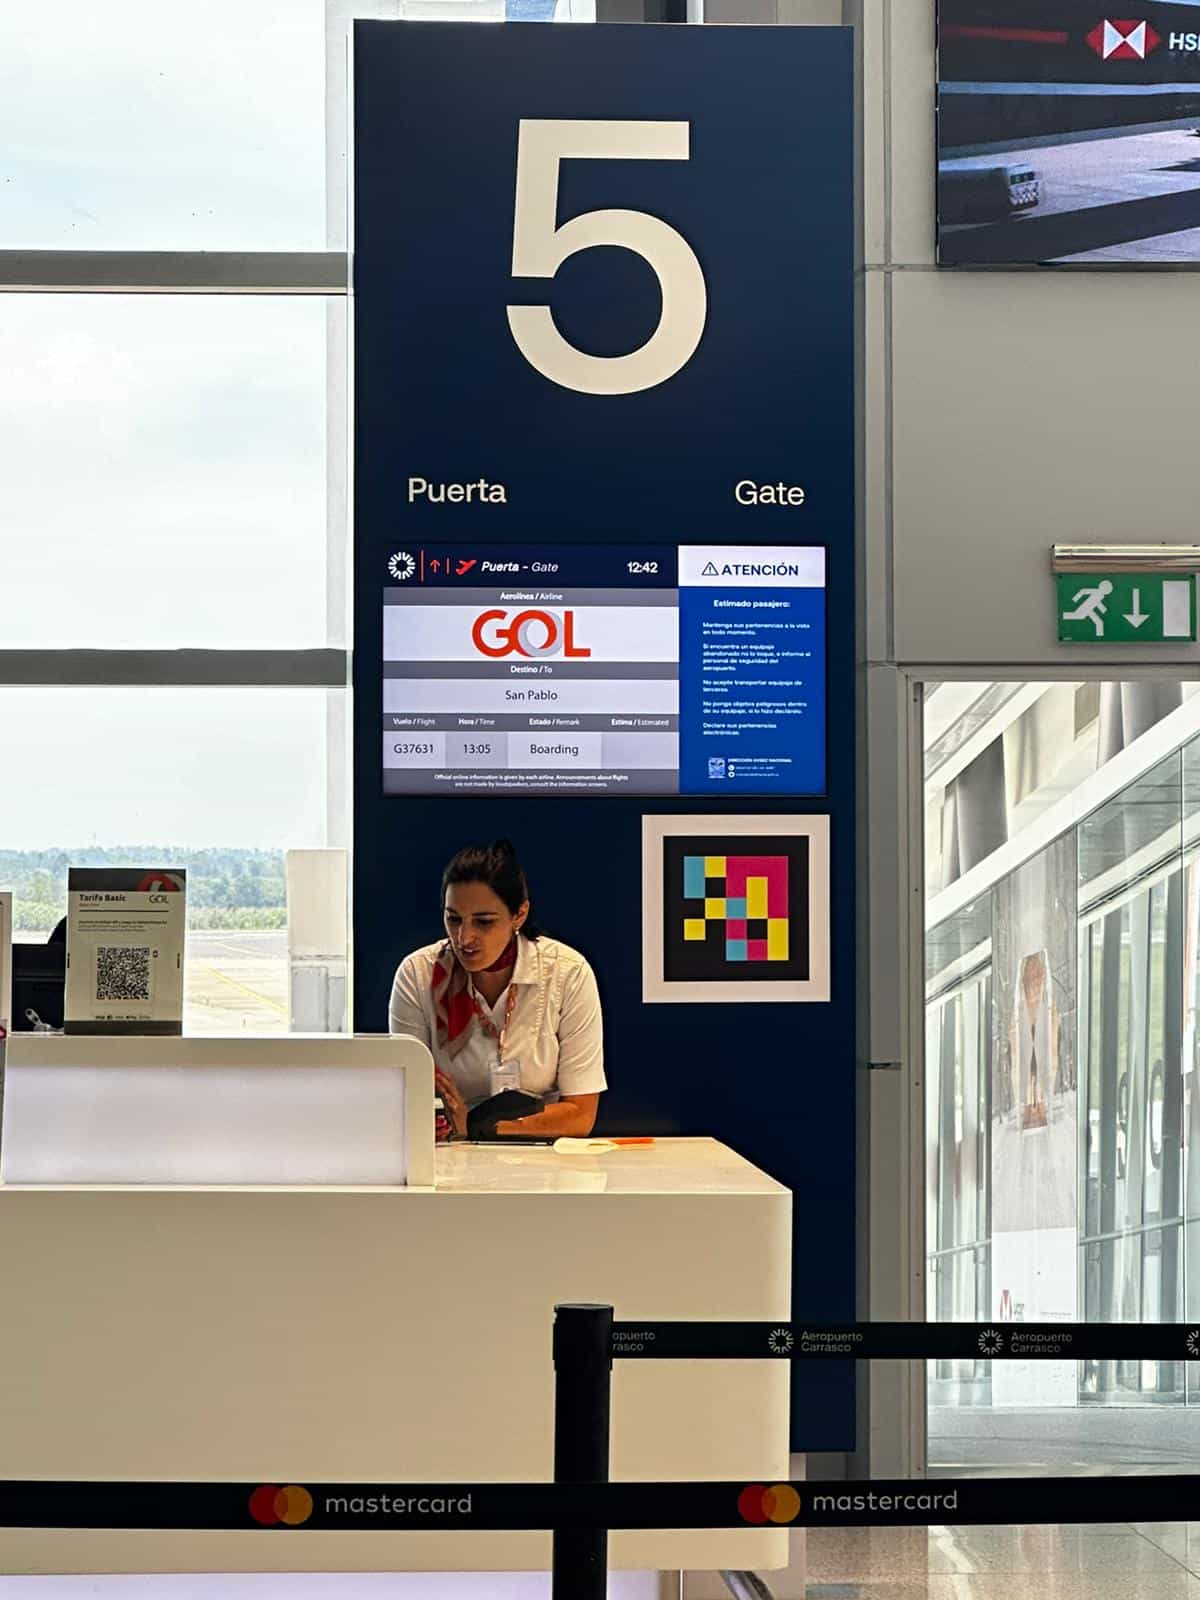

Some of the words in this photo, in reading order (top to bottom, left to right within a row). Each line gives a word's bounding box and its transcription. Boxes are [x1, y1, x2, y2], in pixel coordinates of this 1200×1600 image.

[506, 118, 707, 396] 5
[407, 477, 507, 503] Puerta
[735, 480, 805, 506] Gate
[481, 561, 520, 572] Puerta
[531, 561, 559, 573] Gate
[627, 562, 659, 573] 12:42
[721, 562, 799, 576] ATENCIÓN
[540, 592, 563, 600] Airline
[472, 609, 591, 658] GOL
[510, 665, 538, 673] Destino
[544, 665, 553, 673] To
[505, 690, 525, 701] San
[528, 690, 558, 701] Pablo
[529, 718, 551, 726] Estado
[393, 744, 434, 754] G37631
[463, 744, 491, 754] 13:05
[530, 744, 579, 756] Boarding
[105, 894, 127, 902] Basic
[612, 1330, 656, 1342] opuerto
[801, 1331, 863, 1343] Aeropuerto
[1011, 1332, 1073, 1344] Aeropuerto
[612, 1342, 644, 1351] rasco
[801, 1342, 852, 1352] Carrasco
[1010, 1343, 1062, 1353] Carrasco
[326, 1493, 472, 1513] mastercard
[813, 1489, 959, 1511] mastercard
